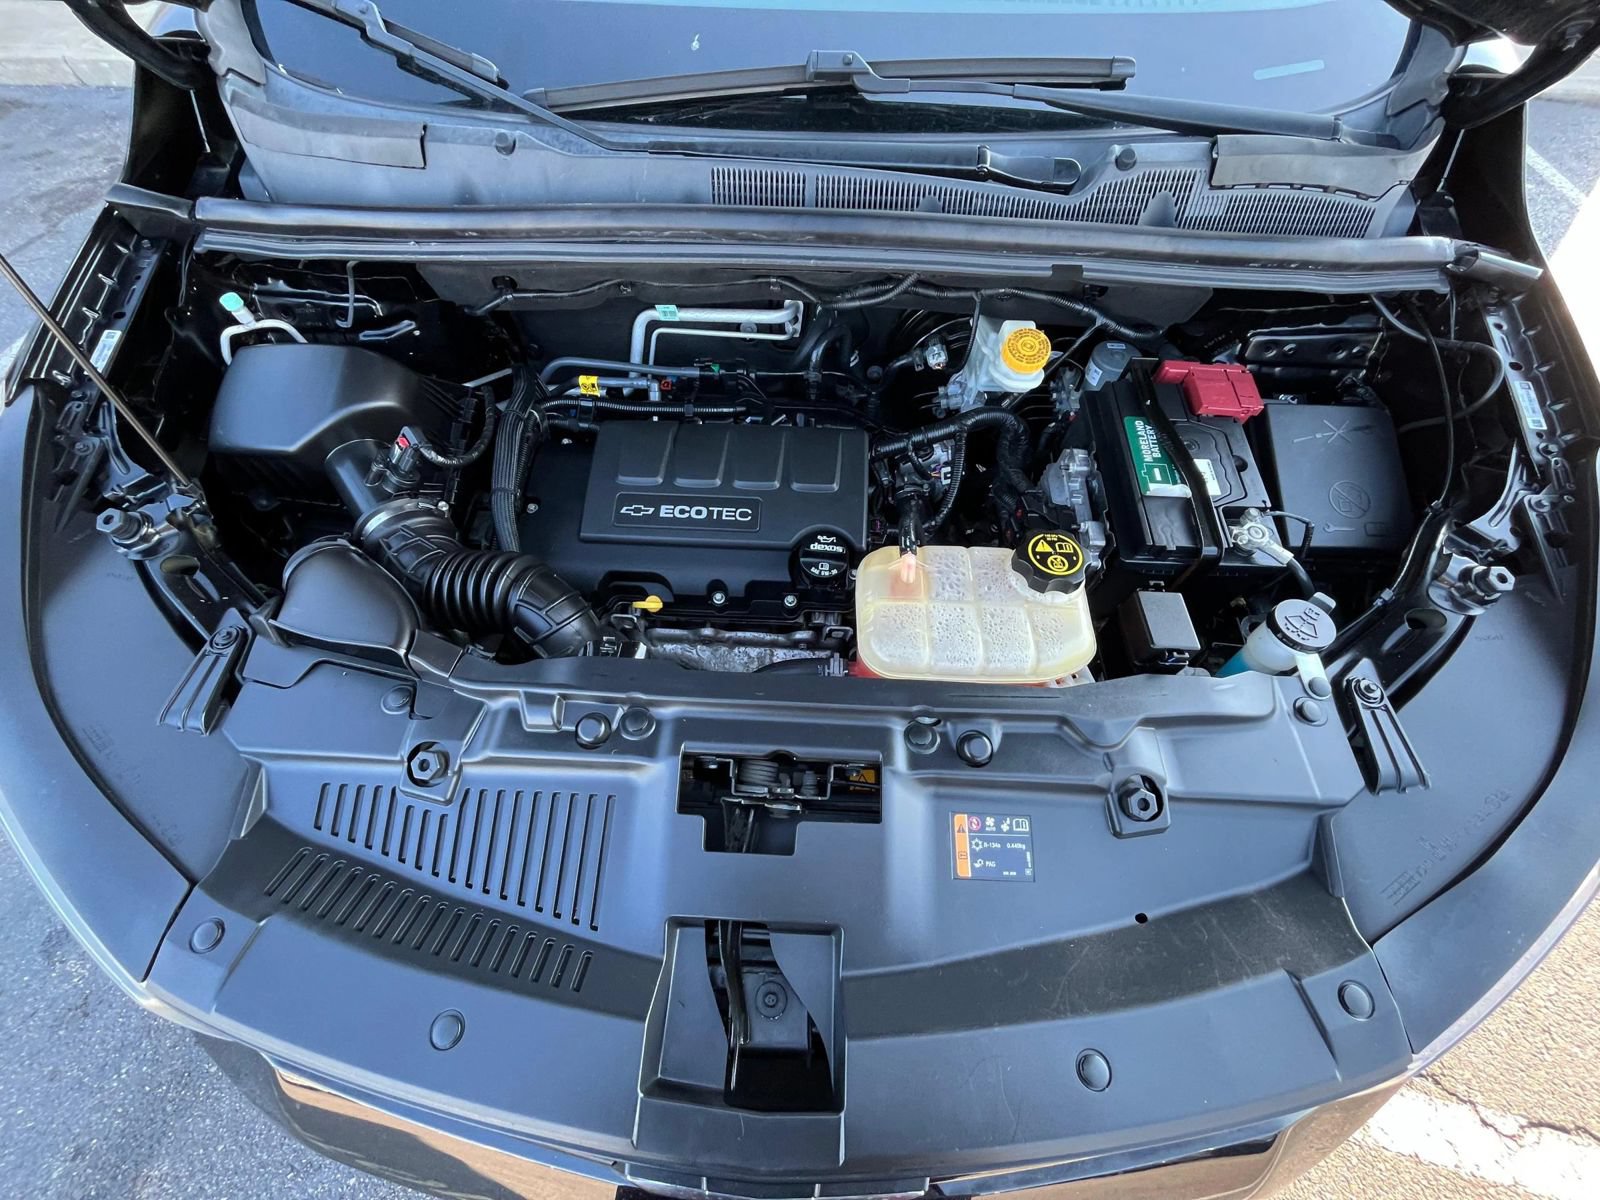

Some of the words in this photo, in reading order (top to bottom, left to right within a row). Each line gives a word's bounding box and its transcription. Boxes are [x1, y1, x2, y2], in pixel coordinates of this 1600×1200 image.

[1134, 420, 1154, 463] MORELAND
[1144, 424, 1161, 459] BATTERY
[659, 505, 752, 521] ECOTEC
